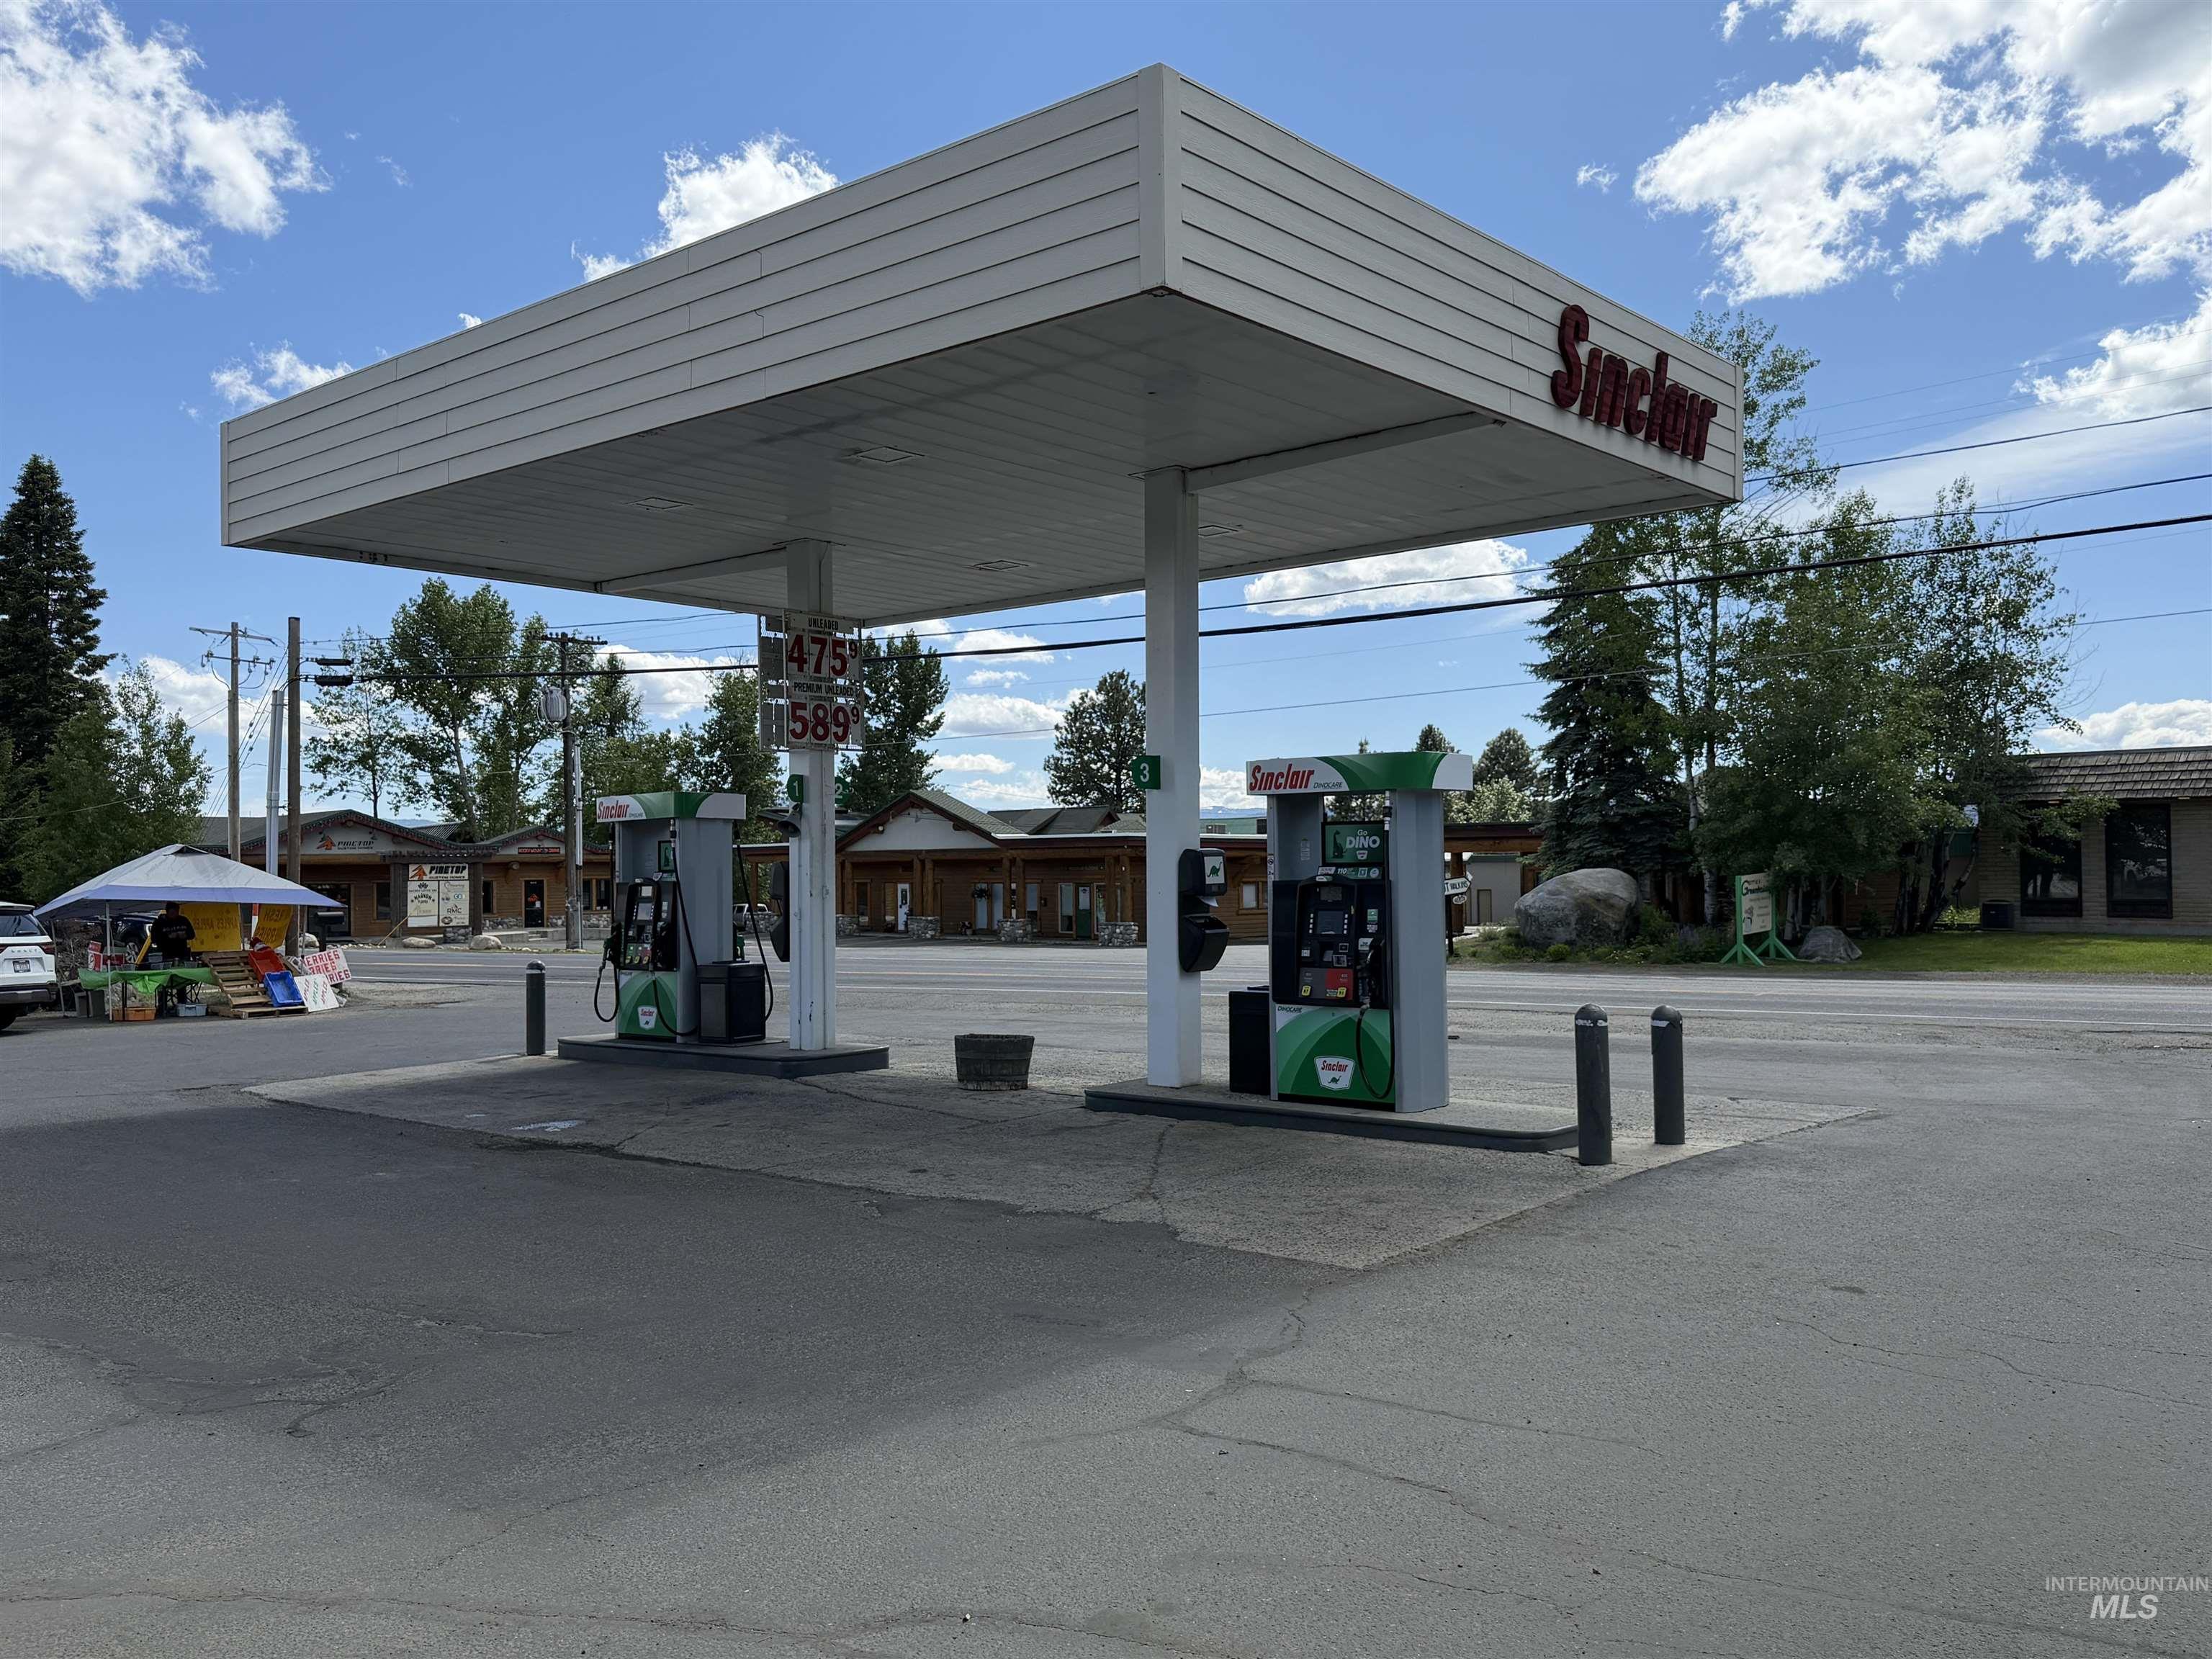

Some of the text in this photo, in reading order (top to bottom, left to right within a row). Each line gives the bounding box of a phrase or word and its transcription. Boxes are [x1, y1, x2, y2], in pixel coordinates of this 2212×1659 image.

[1551, 305, 1717, 461] Sinclair
[808, 617, 839, 631] UNLEADED
[793, 682, 854, 697] PREMIUM UNLEADED
[1140, 763, 1150, 783] 3
[1249, 763, 1315, 791] Sinclair
[793, 781, 799, 796] 1
[835, 783, 842, 799] 2
[598, 800, 629, 819] Sinclair
[1346, 836, 1380, 848] DINO
[1321, 1060, 1348, 1072] Sinclair
